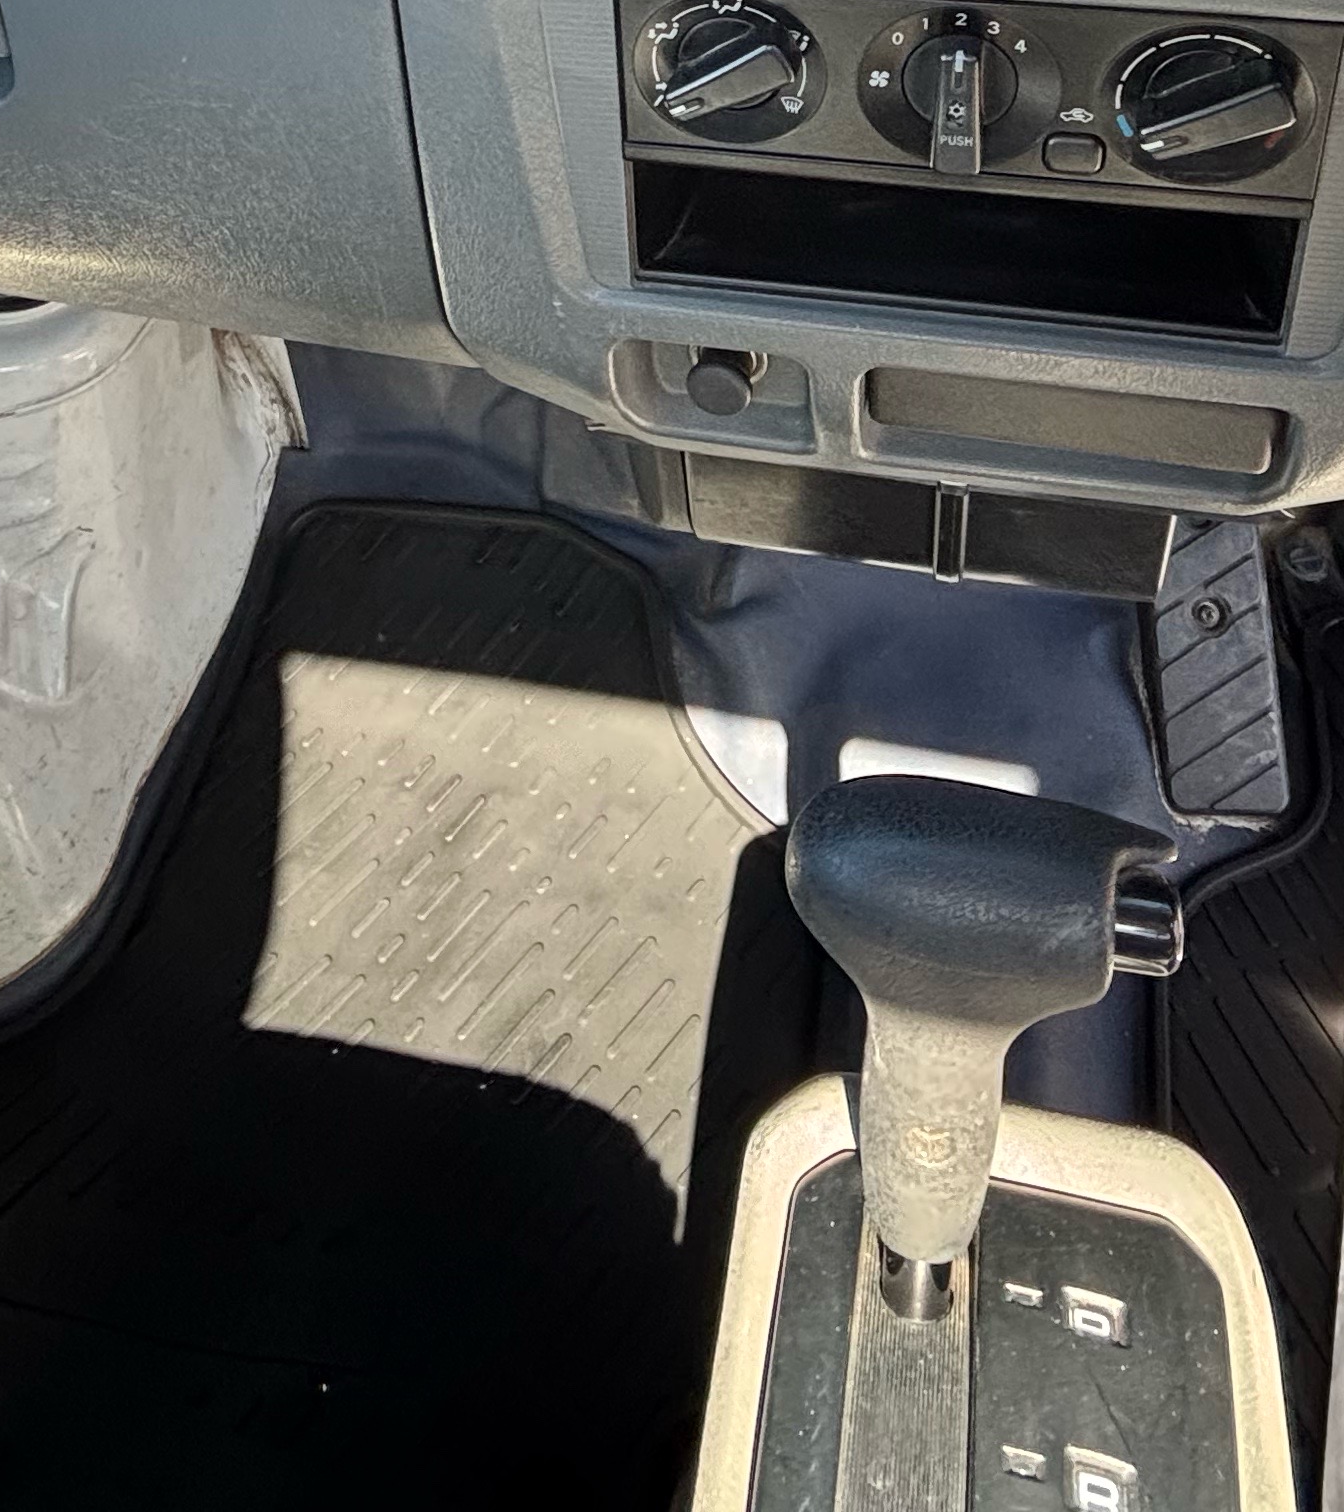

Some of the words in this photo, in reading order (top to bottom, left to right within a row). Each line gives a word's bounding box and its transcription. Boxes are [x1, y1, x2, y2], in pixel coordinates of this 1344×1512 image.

[891, 31, 904, 45] 0
[922, 17, 929, 31] 1
[955, 13, 968, 27] 2
[987, 21, 1000, 35] 3
[1014, 39, 1027, 53] 4
[939, 134, 974, 147] PUSH
